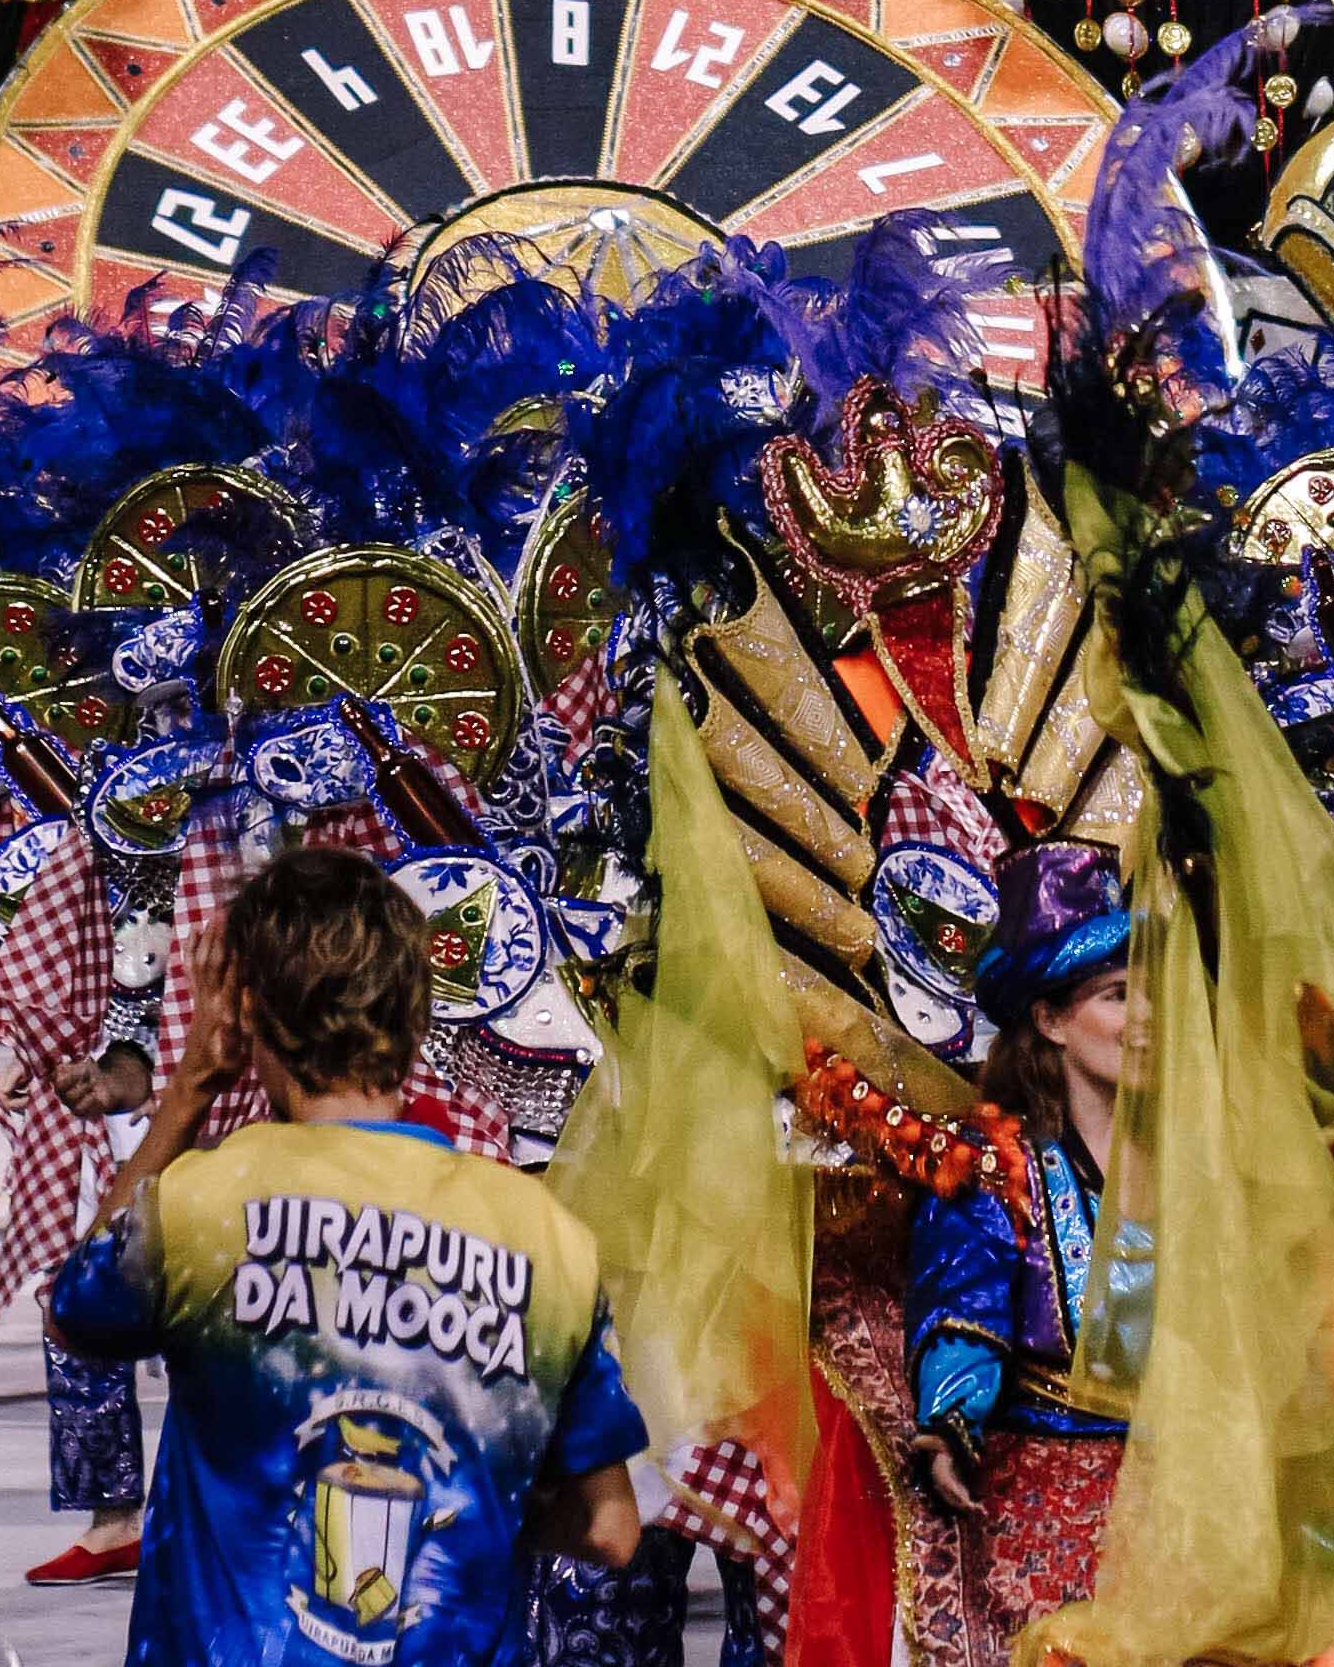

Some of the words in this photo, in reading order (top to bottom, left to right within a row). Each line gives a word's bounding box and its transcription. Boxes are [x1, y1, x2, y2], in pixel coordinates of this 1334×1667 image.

[301, 49, 379, 112] 4
[405, 4, 495, 78] 18
[651, 9, 747, 89] 21
[765, 60, 863, 136] 13
[190, 97, 306, 185] 33
[152, 188, 251, 266] 27
[245, 1194, 530, 1311] UIRAPURU
[233, 1262, 316, 1337] DA
[335, 1269, 528, 1381] MOOCA
